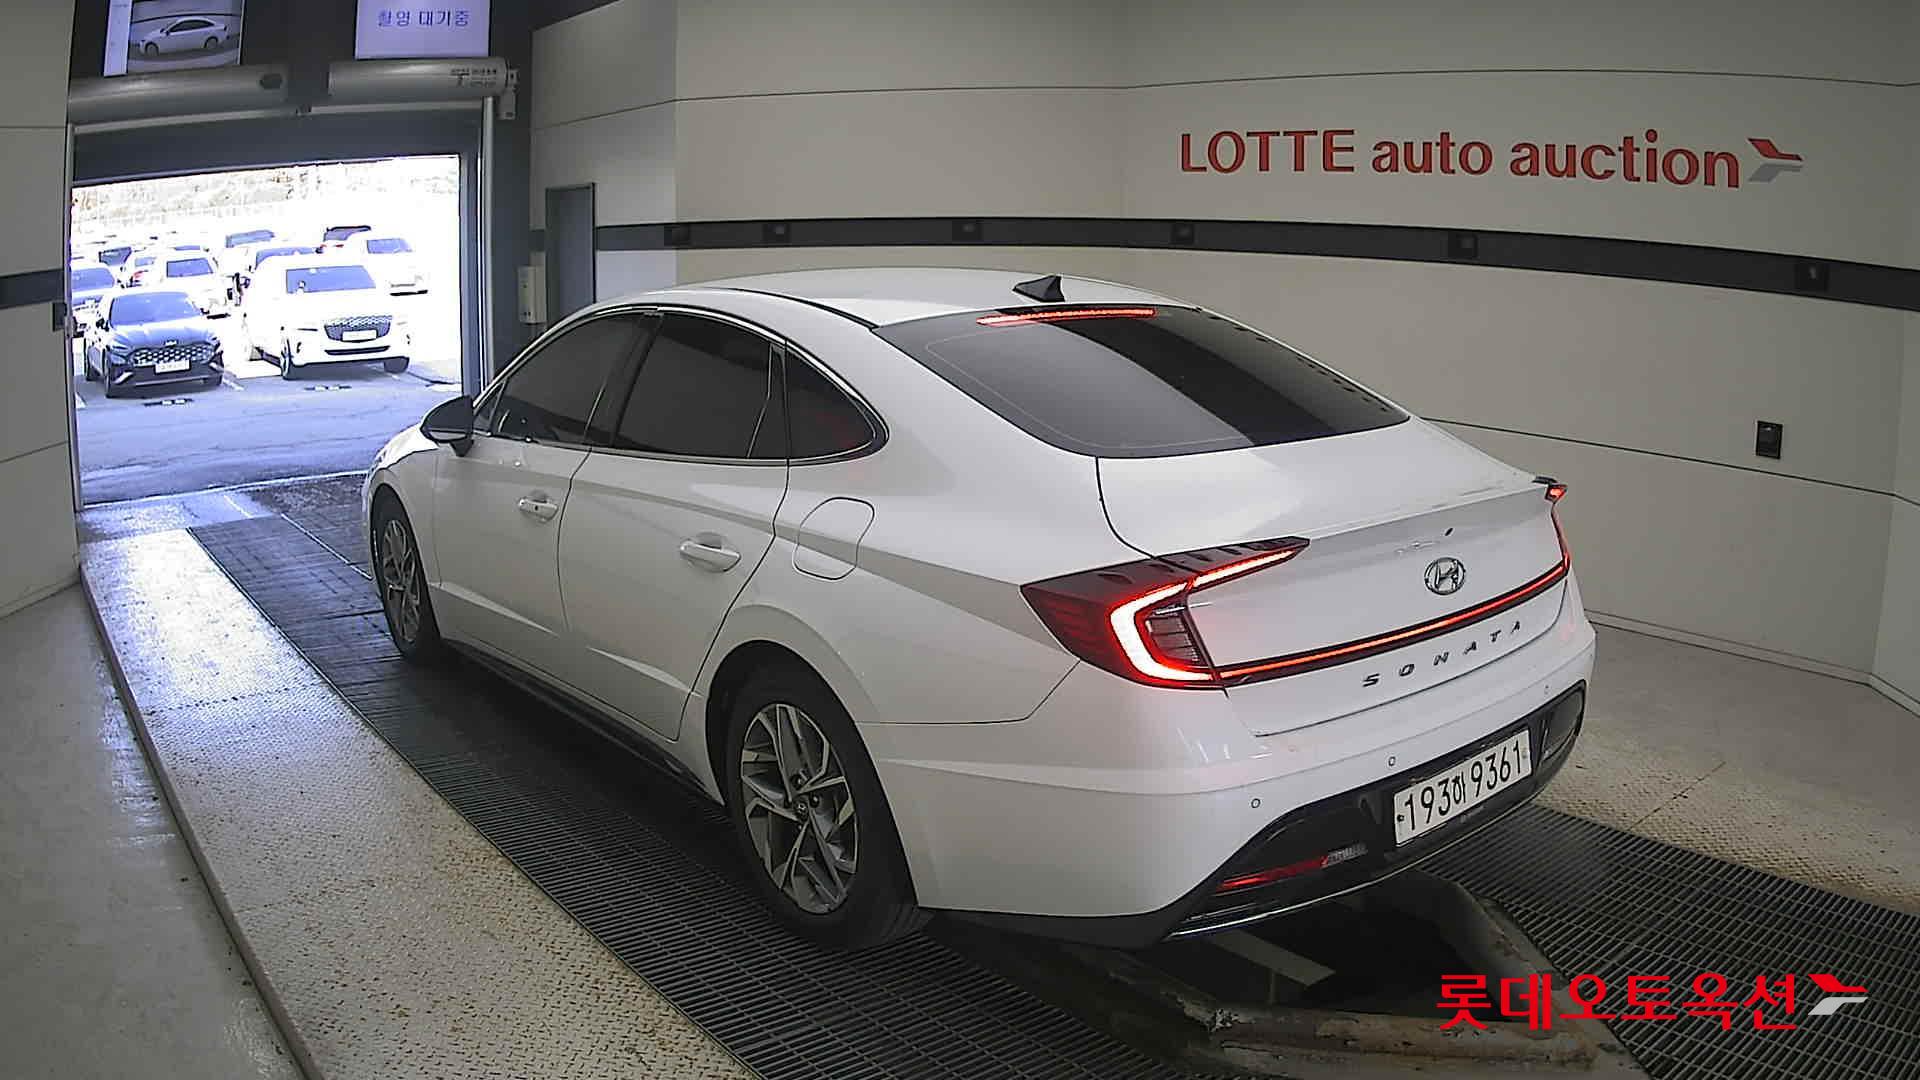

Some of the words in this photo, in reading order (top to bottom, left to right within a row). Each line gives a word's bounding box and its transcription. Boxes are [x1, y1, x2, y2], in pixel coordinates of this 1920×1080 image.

[418, 10, 471, 27] 대기중
[1180, 129, 1355, 172] LOTTE
[1371, 131, 1494, 175] auto
[1509, 129, 1741, 188] auction
[1362, 620, 1521, 687] SONATA
